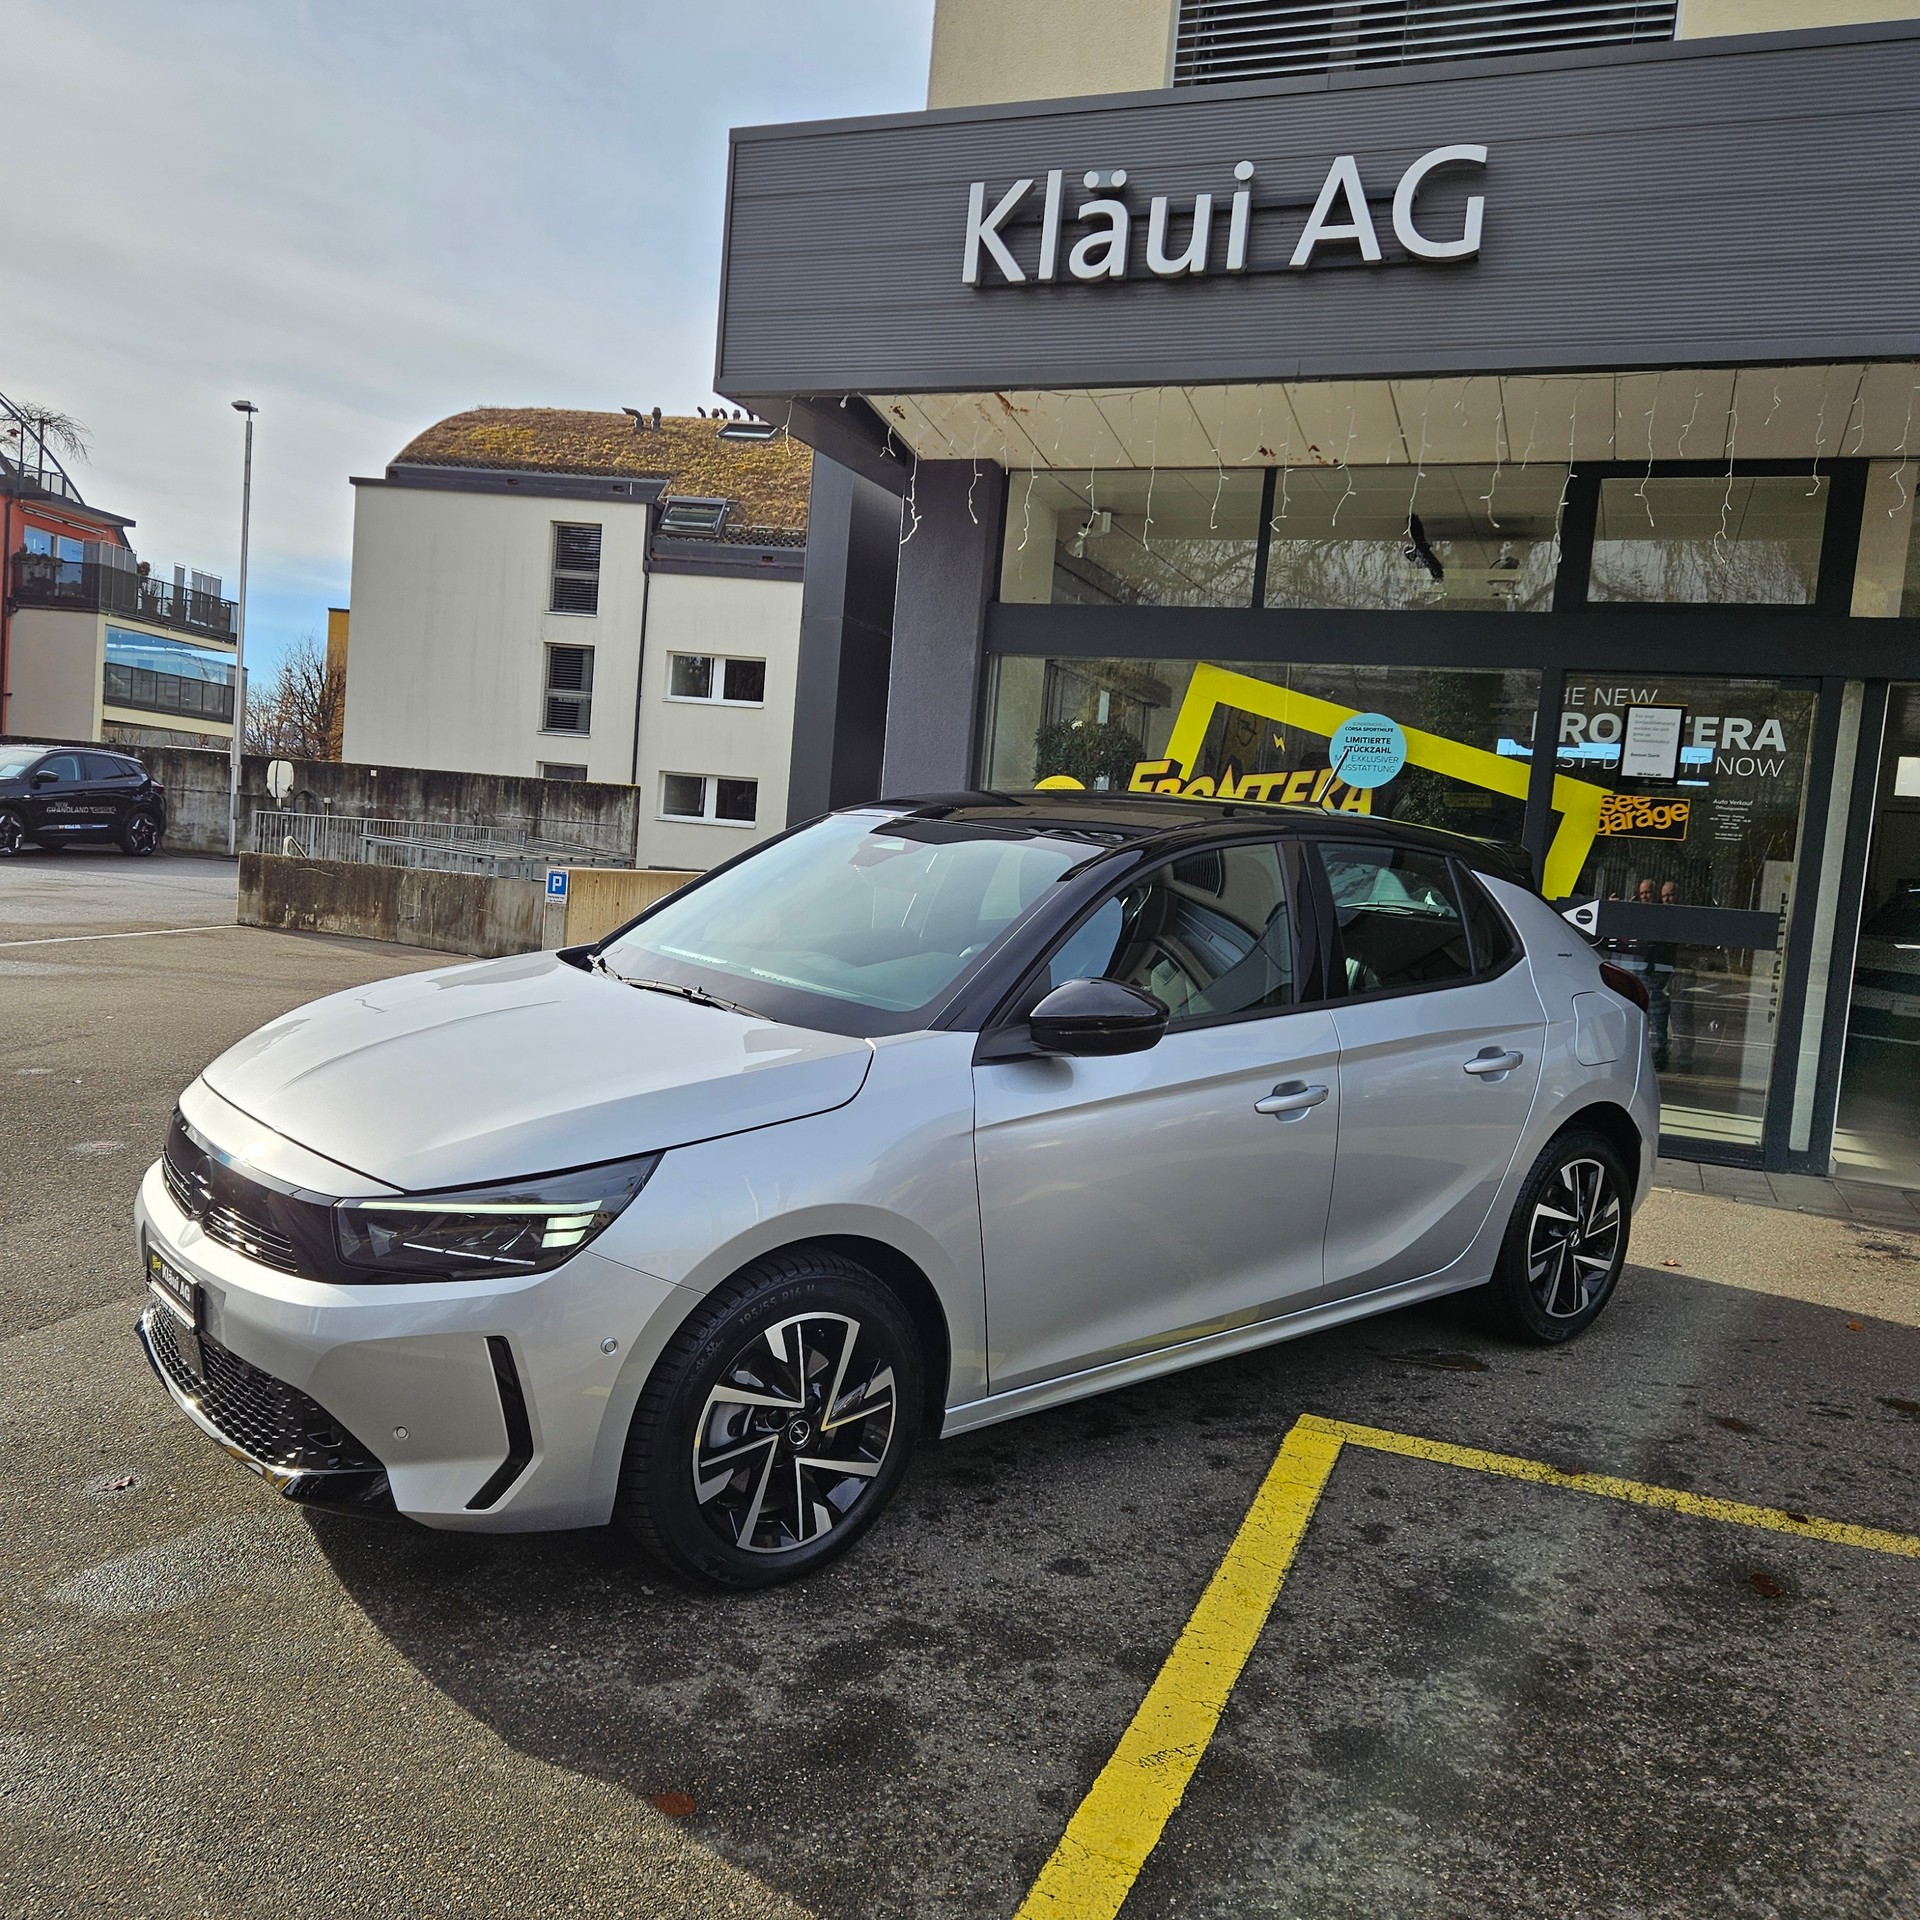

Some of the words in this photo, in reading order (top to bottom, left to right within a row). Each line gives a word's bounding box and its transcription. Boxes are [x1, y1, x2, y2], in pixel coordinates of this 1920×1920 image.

[962, 160, 1253, 286] Kläui
[1289, 144, 1488, 270] AG
[1594, 687, 1658, 706] NEW
[1345, 736, 1392, 745] LIMITIERTE
[1531, 710, 1787, 752] ROERA
[1343, 744, 1392, 754] STÜCKZAHL
[1341, 763, 1396, 773] USSTATTUNG
[1351, 754, 1399, 764] EXKLUSIVER
[1714, 756, 1785, 777] NOW
[1601, 795, 1652, 815] see
[1597, 803, 1688, 836] garage
[552, 875, 562, 892] P
[162, 1263, 179, 1292] Kläui
[180, 1281, 190, 1302] AG
